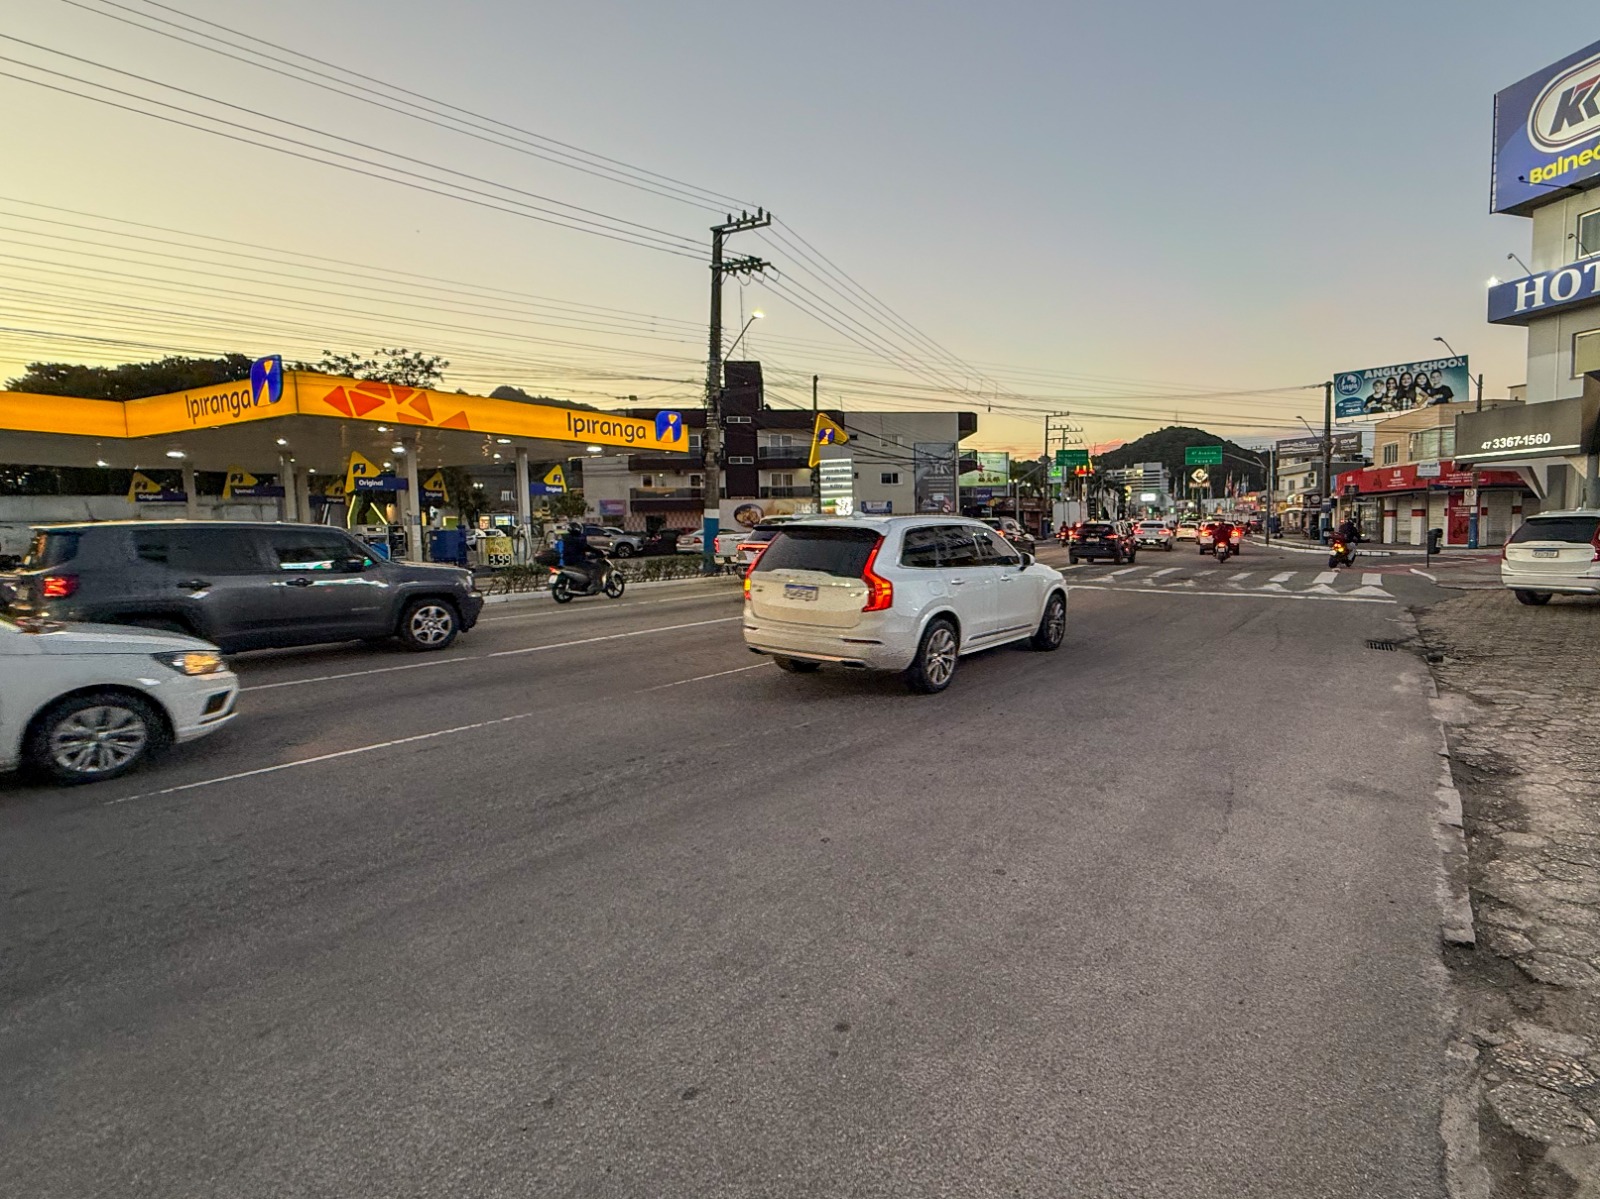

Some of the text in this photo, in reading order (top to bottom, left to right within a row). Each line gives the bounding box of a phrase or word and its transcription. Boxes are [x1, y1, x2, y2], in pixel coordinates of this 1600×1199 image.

[1514, 261, 1600, 312] HOT
[1364, 365, 1407, 379] ANGLO
[185, 389, 251, 425] Ipiranga
[567, 411, 646, 443] Ipiranga
[1481, 432, 1551, 449] 47 3367-1560
[358, 479, 384, 487] Original
